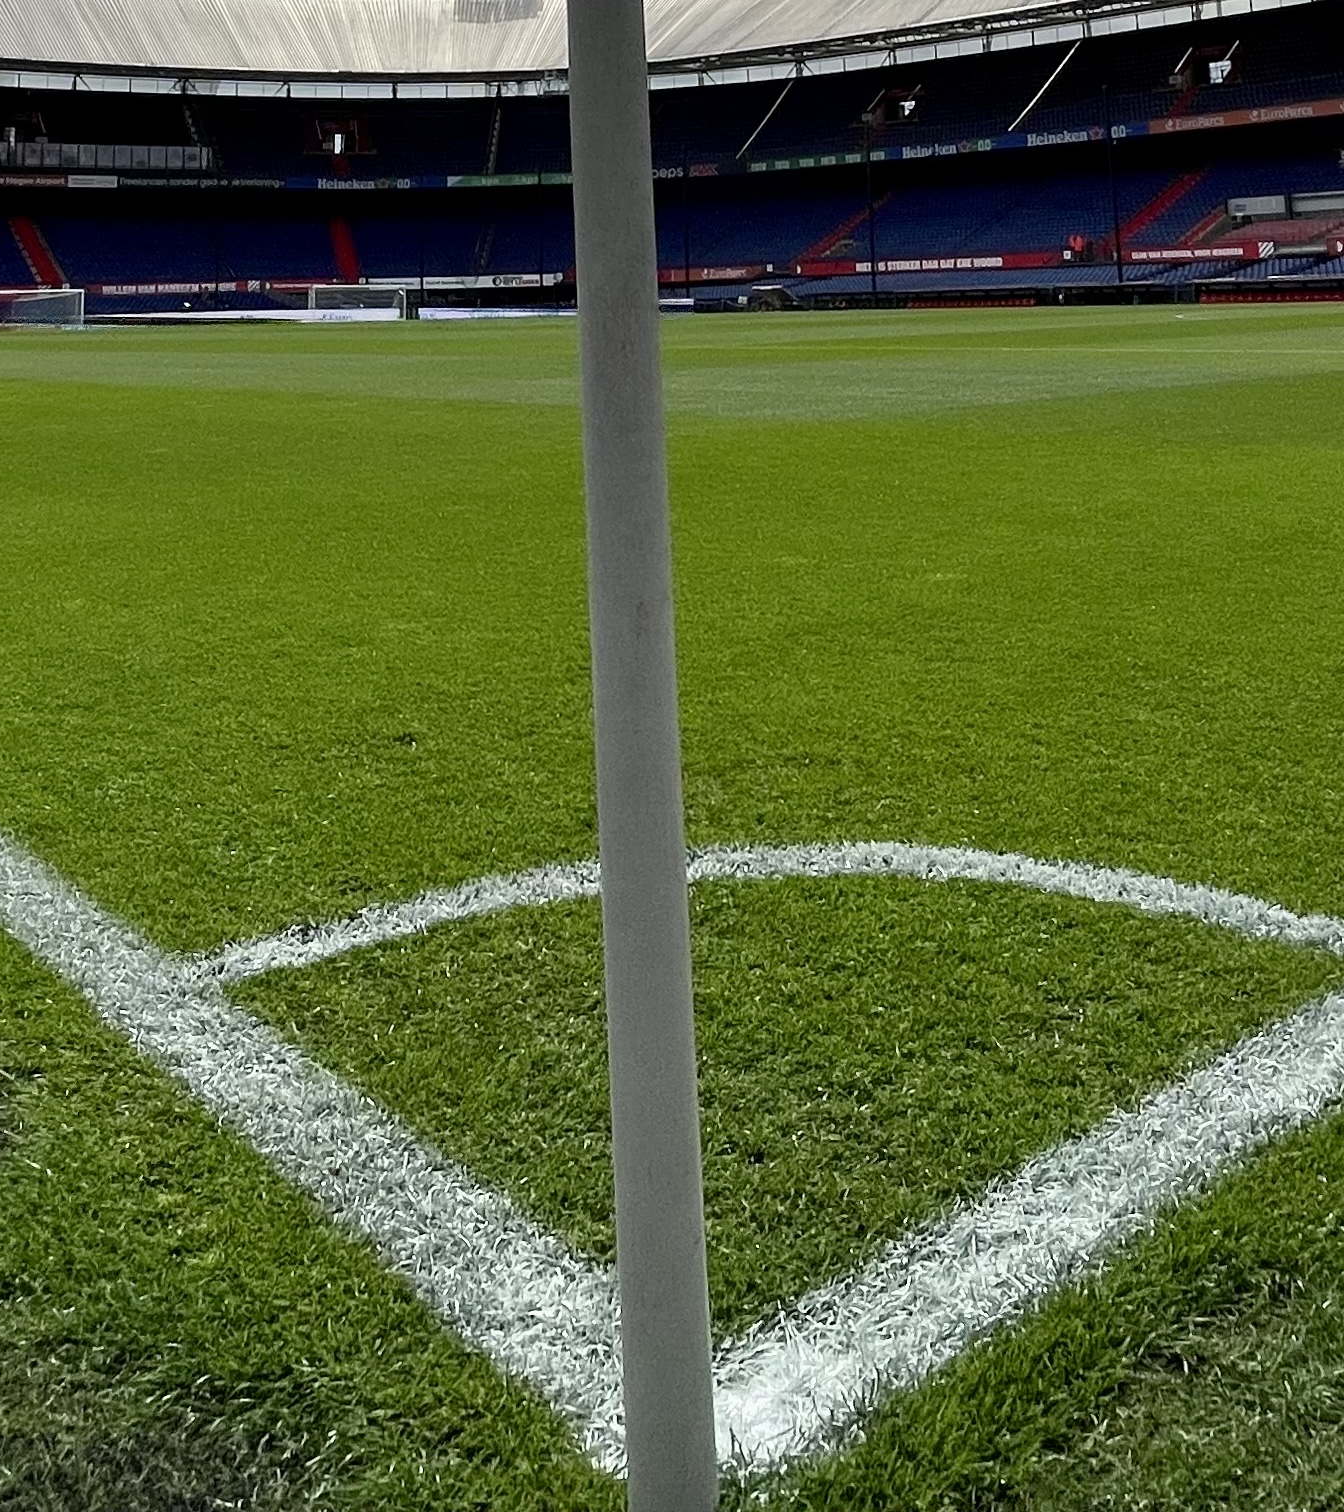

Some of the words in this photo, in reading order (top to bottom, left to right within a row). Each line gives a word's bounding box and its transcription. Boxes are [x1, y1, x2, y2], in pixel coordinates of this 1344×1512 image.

[1260, 106, 1313, 120] EuroParcs
[1175, 116, 1225, 130] EuroParcs
[1027, 130, 1088, 147] Heineken
[36, 177, 66, 186] Airport
[317, 177, 376, 189] Heineken
